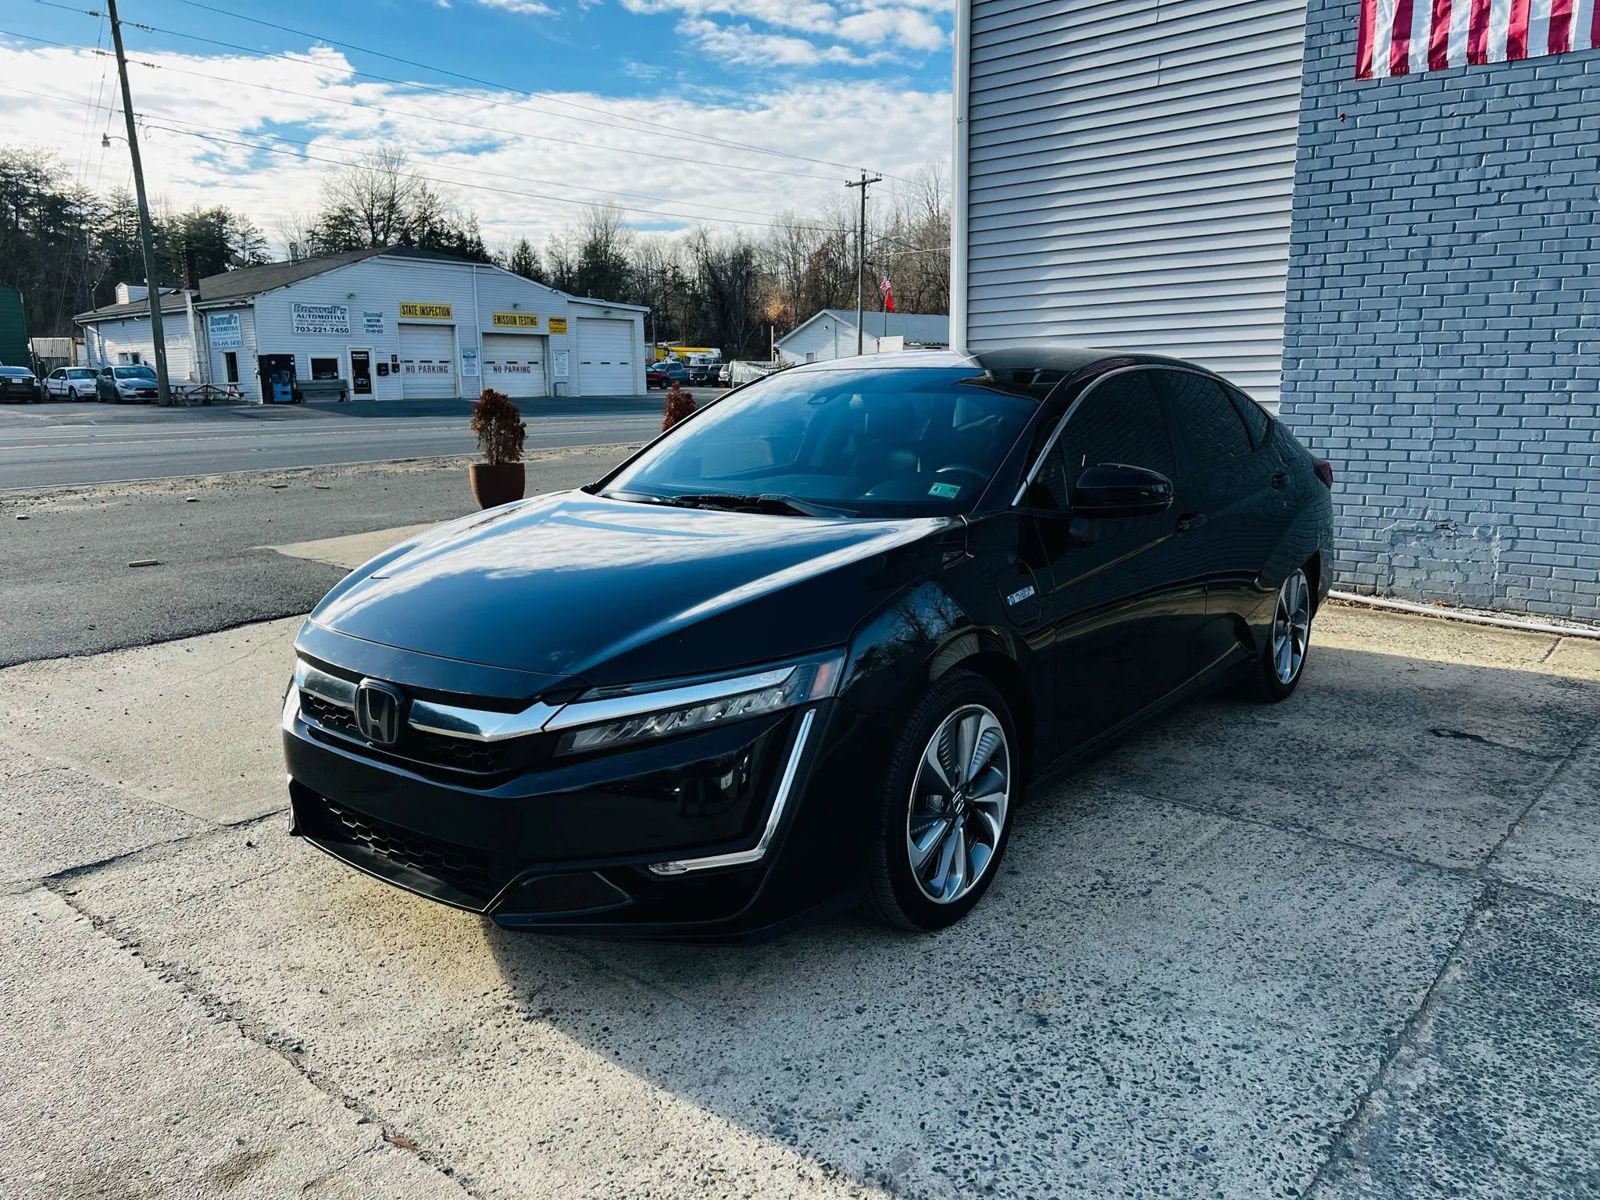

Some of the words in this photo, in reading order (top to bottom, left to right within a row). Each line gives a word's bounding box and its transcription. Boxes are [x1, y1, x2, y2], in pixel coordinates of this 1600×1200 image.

[402, 304, 418, 315] STATE
[420, 305, 450, 316] INSPECTION
[494, 314, 517, 326] EMISSION
[518, 316, 536, 326] TESTING
[405, 366, 415, 374] NO
[418, 366, 448, 374] PARKING
